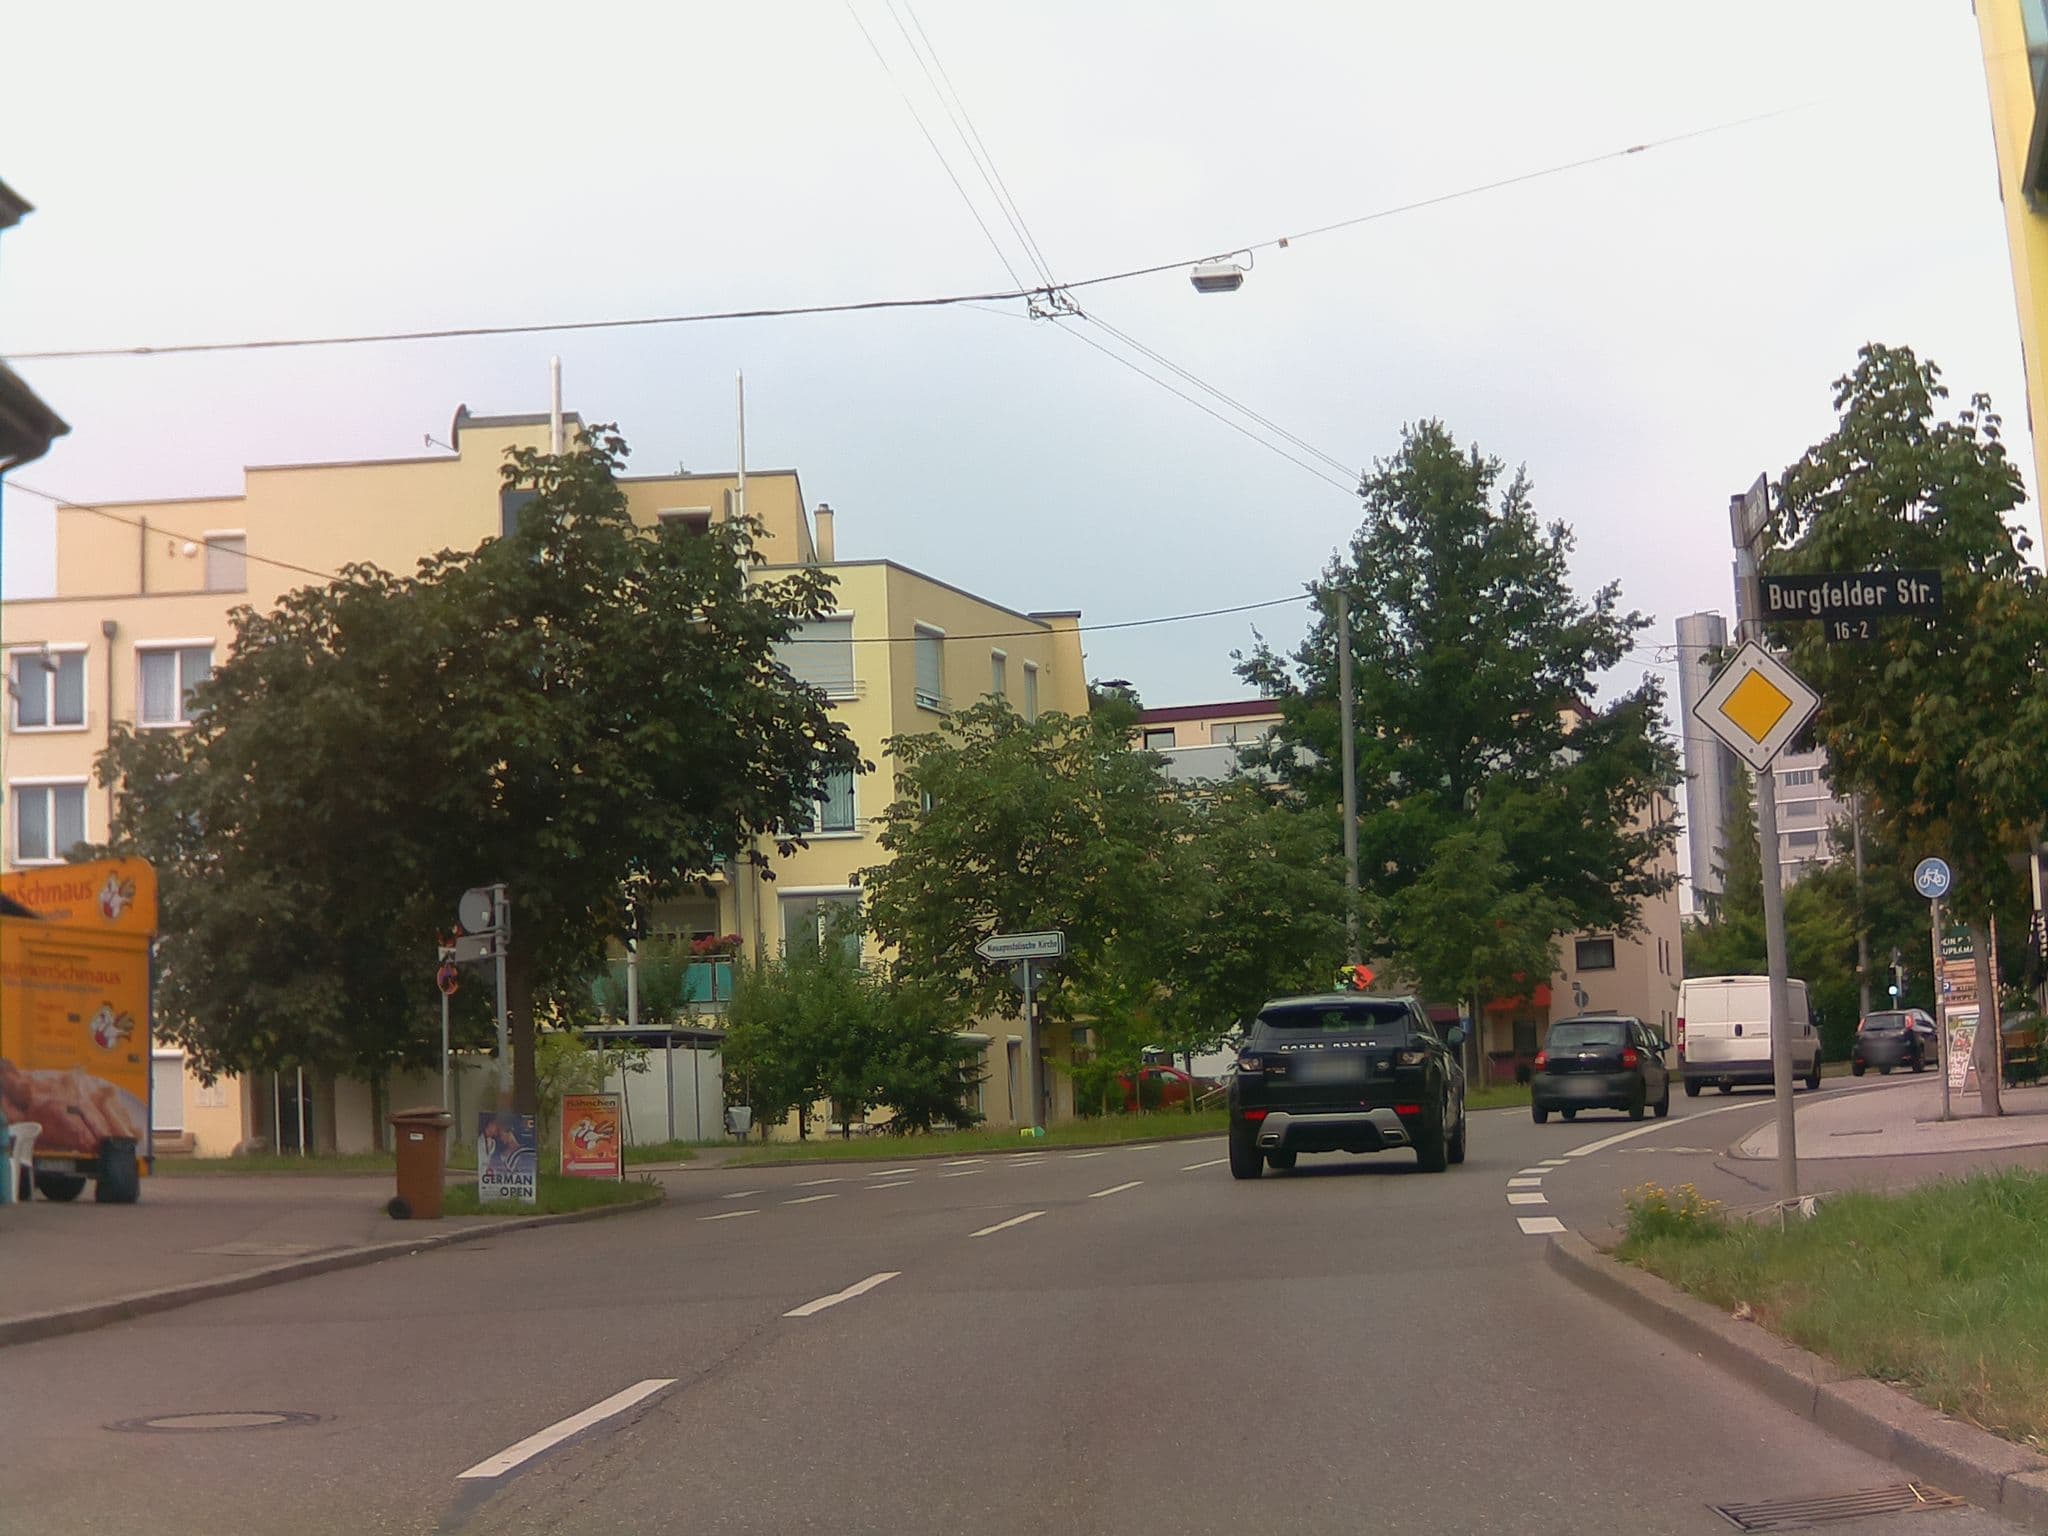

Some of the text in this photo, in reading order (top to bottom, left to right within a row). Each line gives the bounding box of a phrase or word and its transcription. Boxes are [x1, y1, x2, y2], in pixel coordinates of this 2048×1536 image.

[1768, 577, 1935, 615] Burgfelder Str.
[1834, 620, 1870, 640] 16-2
[482, 1173, 532, 1185] GERMAN
[500, 1186, 533, 1197] OPEN
